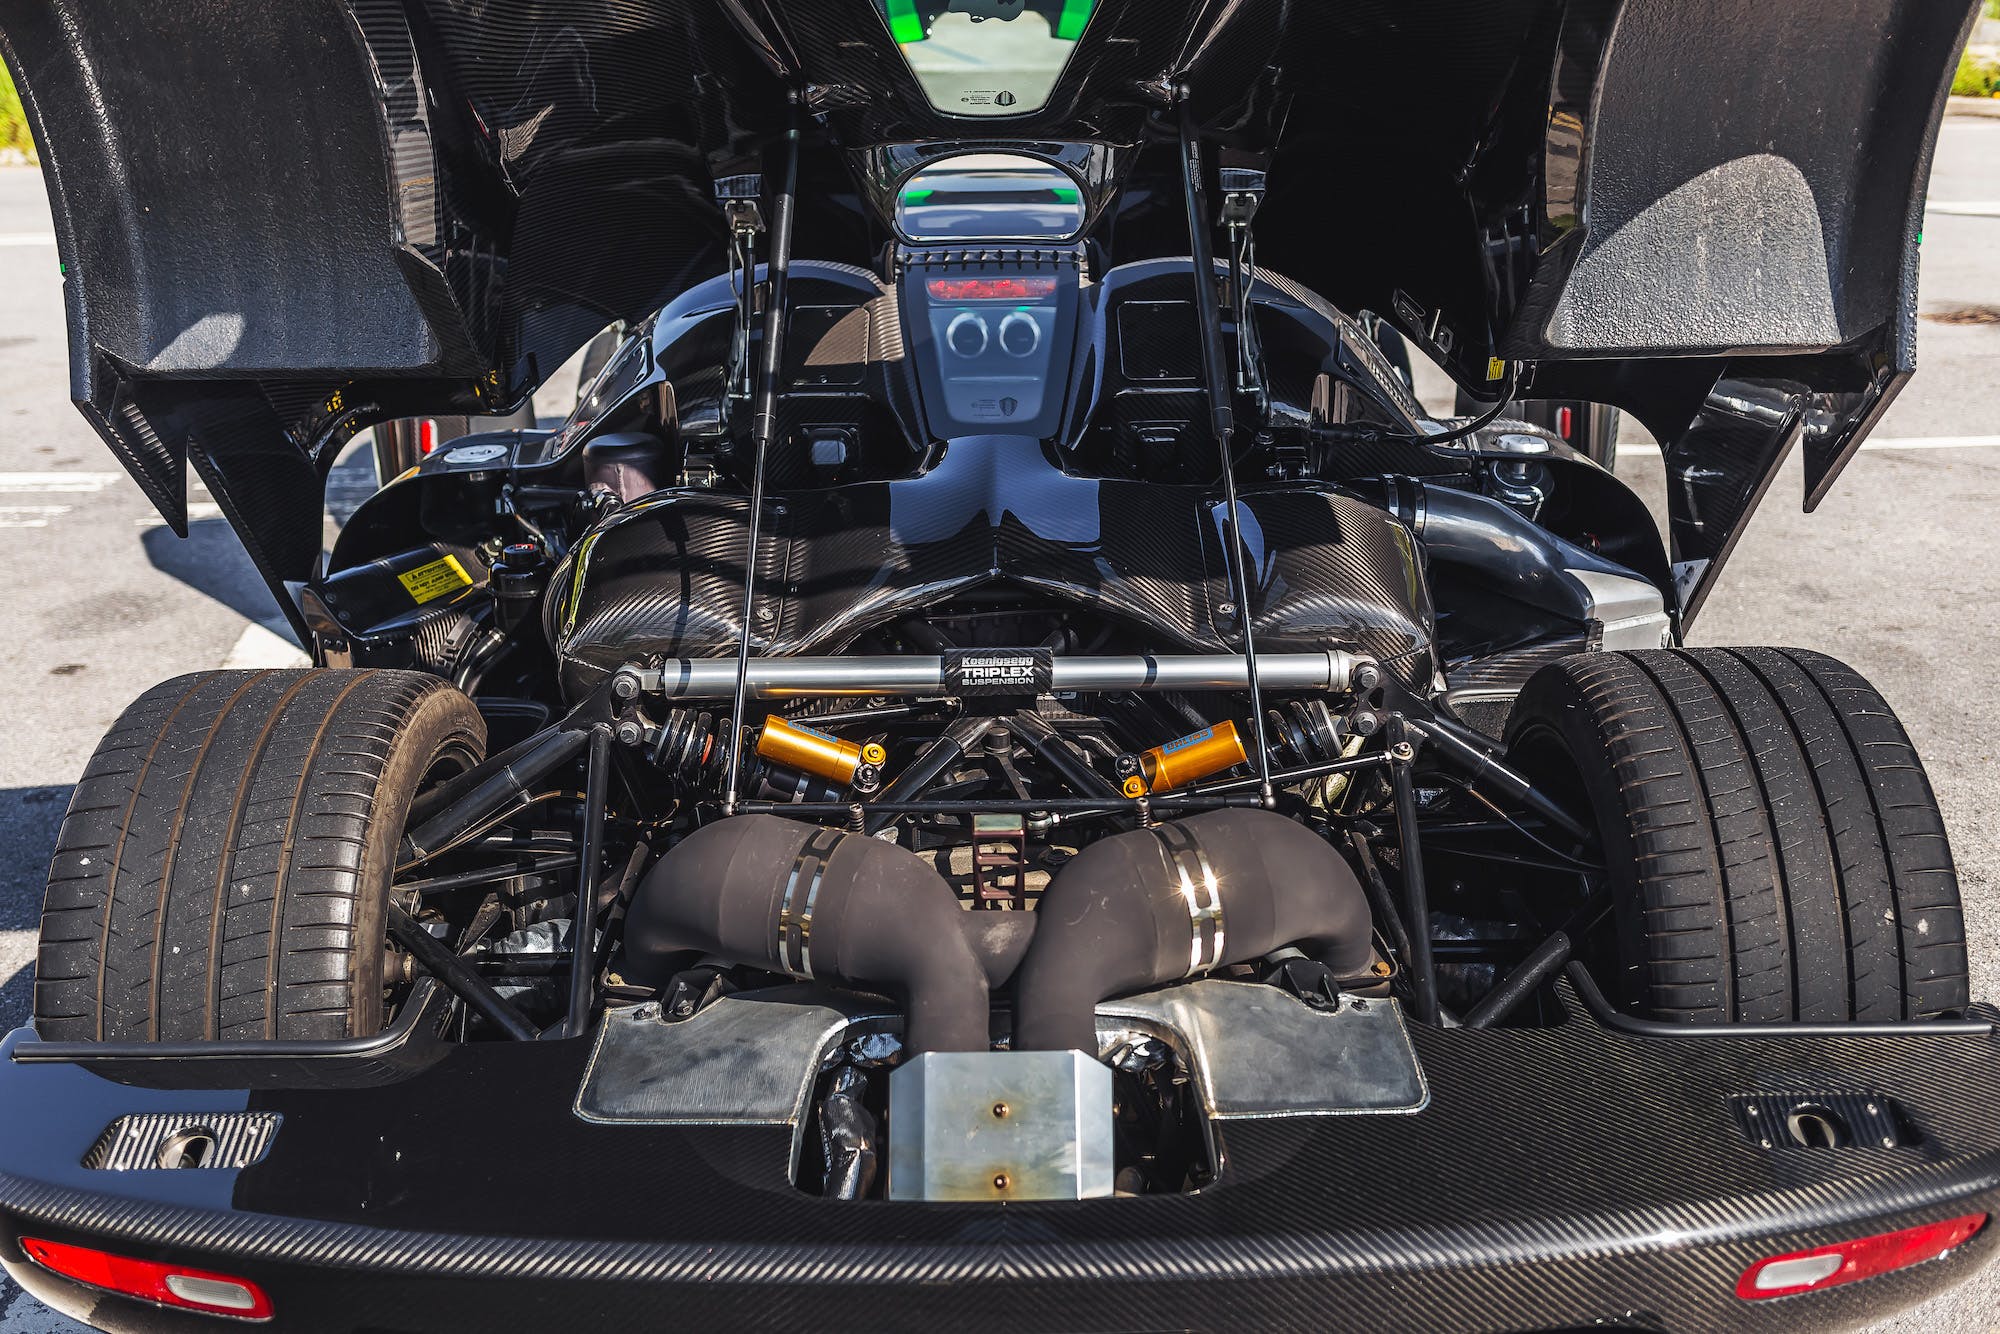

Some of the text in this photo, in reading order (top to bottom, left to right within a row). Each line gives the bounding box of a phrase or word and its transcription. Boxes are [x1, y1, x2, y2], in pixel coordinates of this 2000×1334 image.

[962, 657, 1034, 667] Koenigsegg
[962, 667, 1034, 678] TRIPLEX
[962, 677, 1034, 686] SUSPENSION
